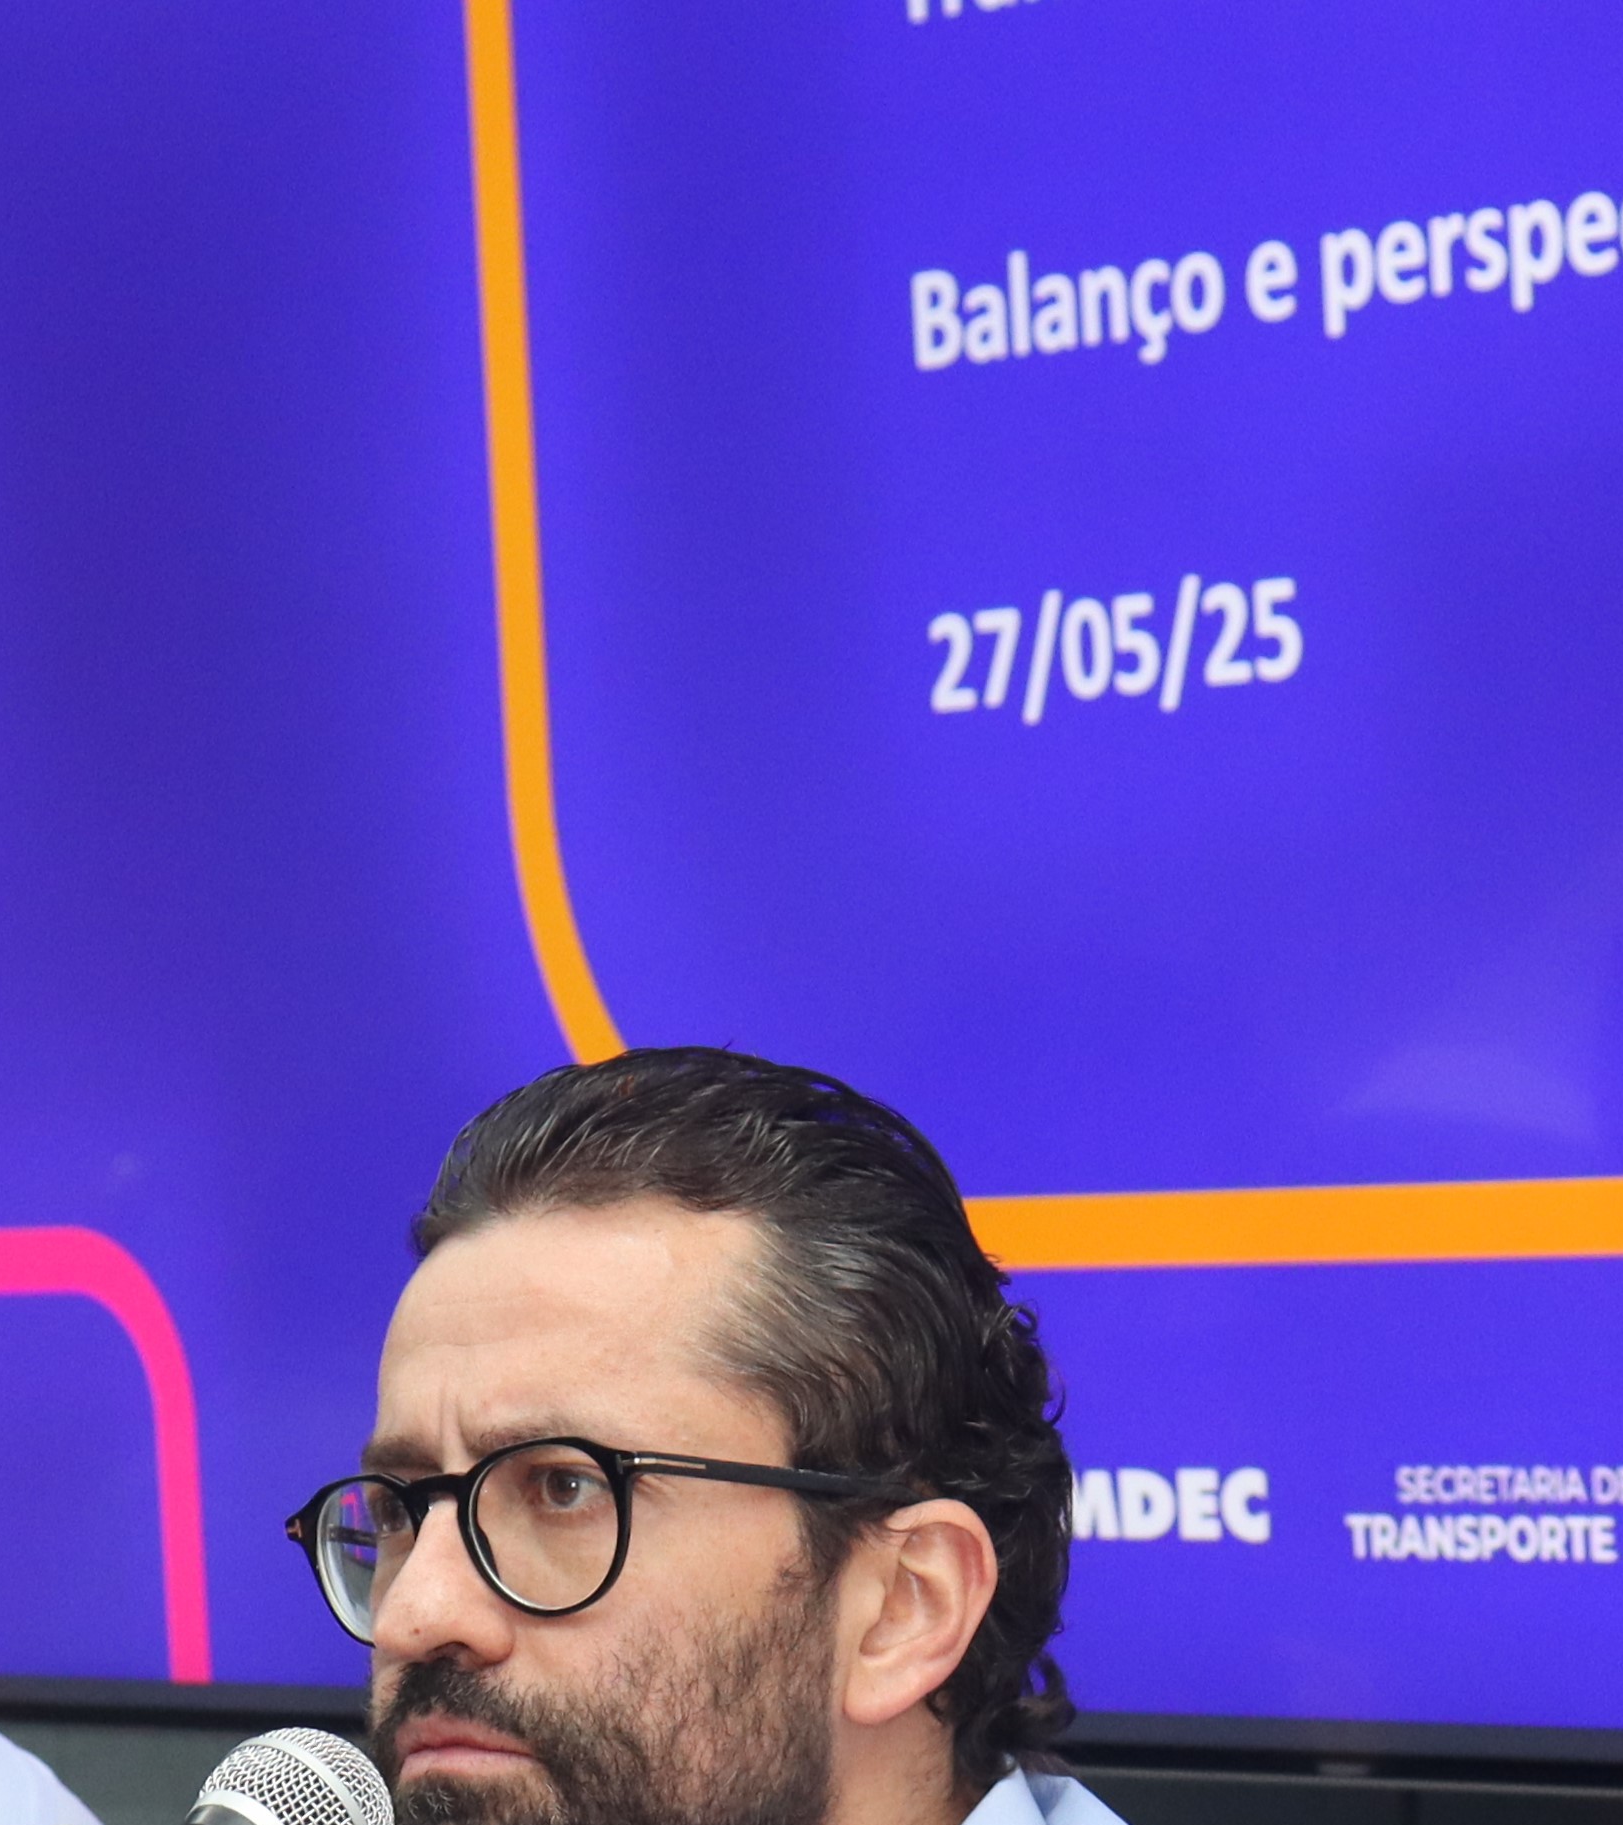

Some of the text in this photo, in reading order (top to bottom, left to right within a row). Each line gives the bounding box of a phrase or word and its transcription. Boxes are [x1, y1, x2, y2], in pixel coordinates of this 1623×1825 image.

[909, 248, 1227, 371] Balanço
[1244, 239, 1299, 323] e
[926, 572, 1305, 727] 27/05/25
[1071, 1466, 1272, 1544] MDEC
[1394, 1464, 1588, 1504] SECRETARIA
[1343, 1512, 1619, 1564] TRANSPORTE
